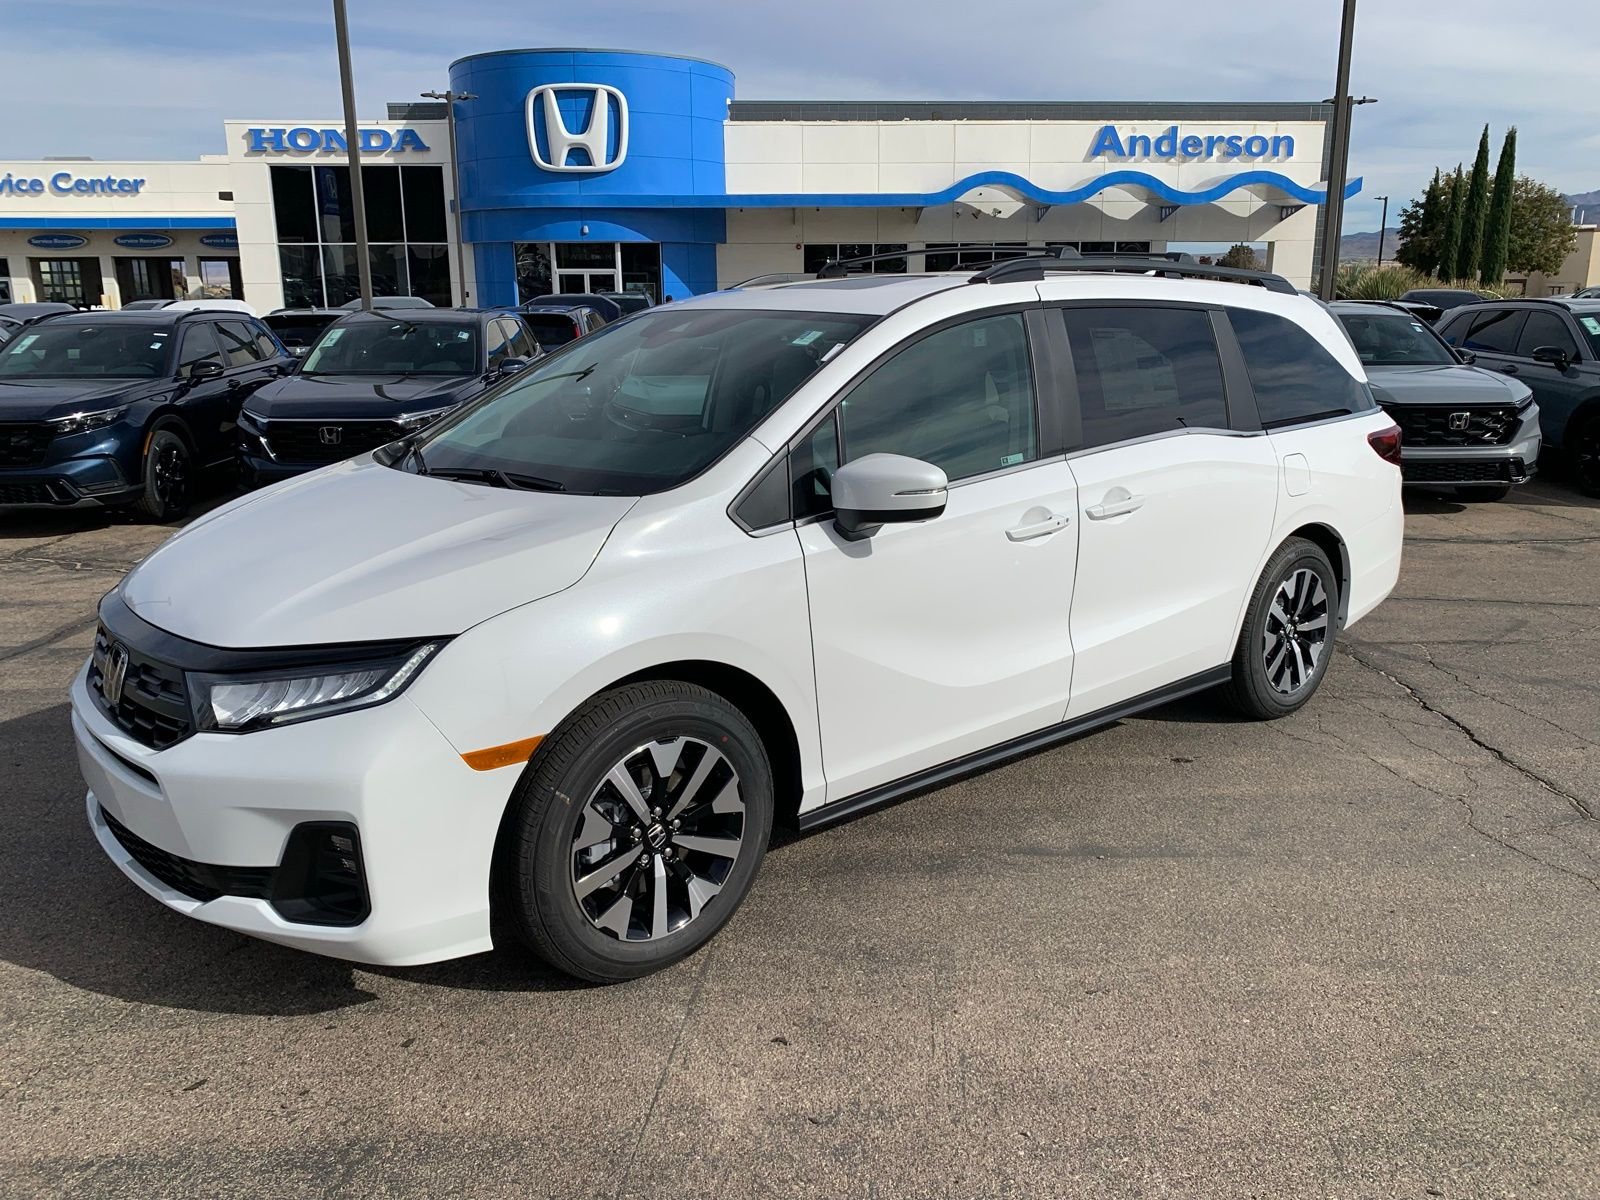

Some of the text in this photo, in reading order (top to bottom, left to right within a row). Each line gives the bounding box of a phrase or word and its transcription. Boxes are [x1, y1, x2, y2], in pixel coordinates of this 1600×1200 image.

[248, 127, 431, 152] HONDA
[1091, 125, 1295, 157] Anderson
[51, 172, 146, 193] Center
